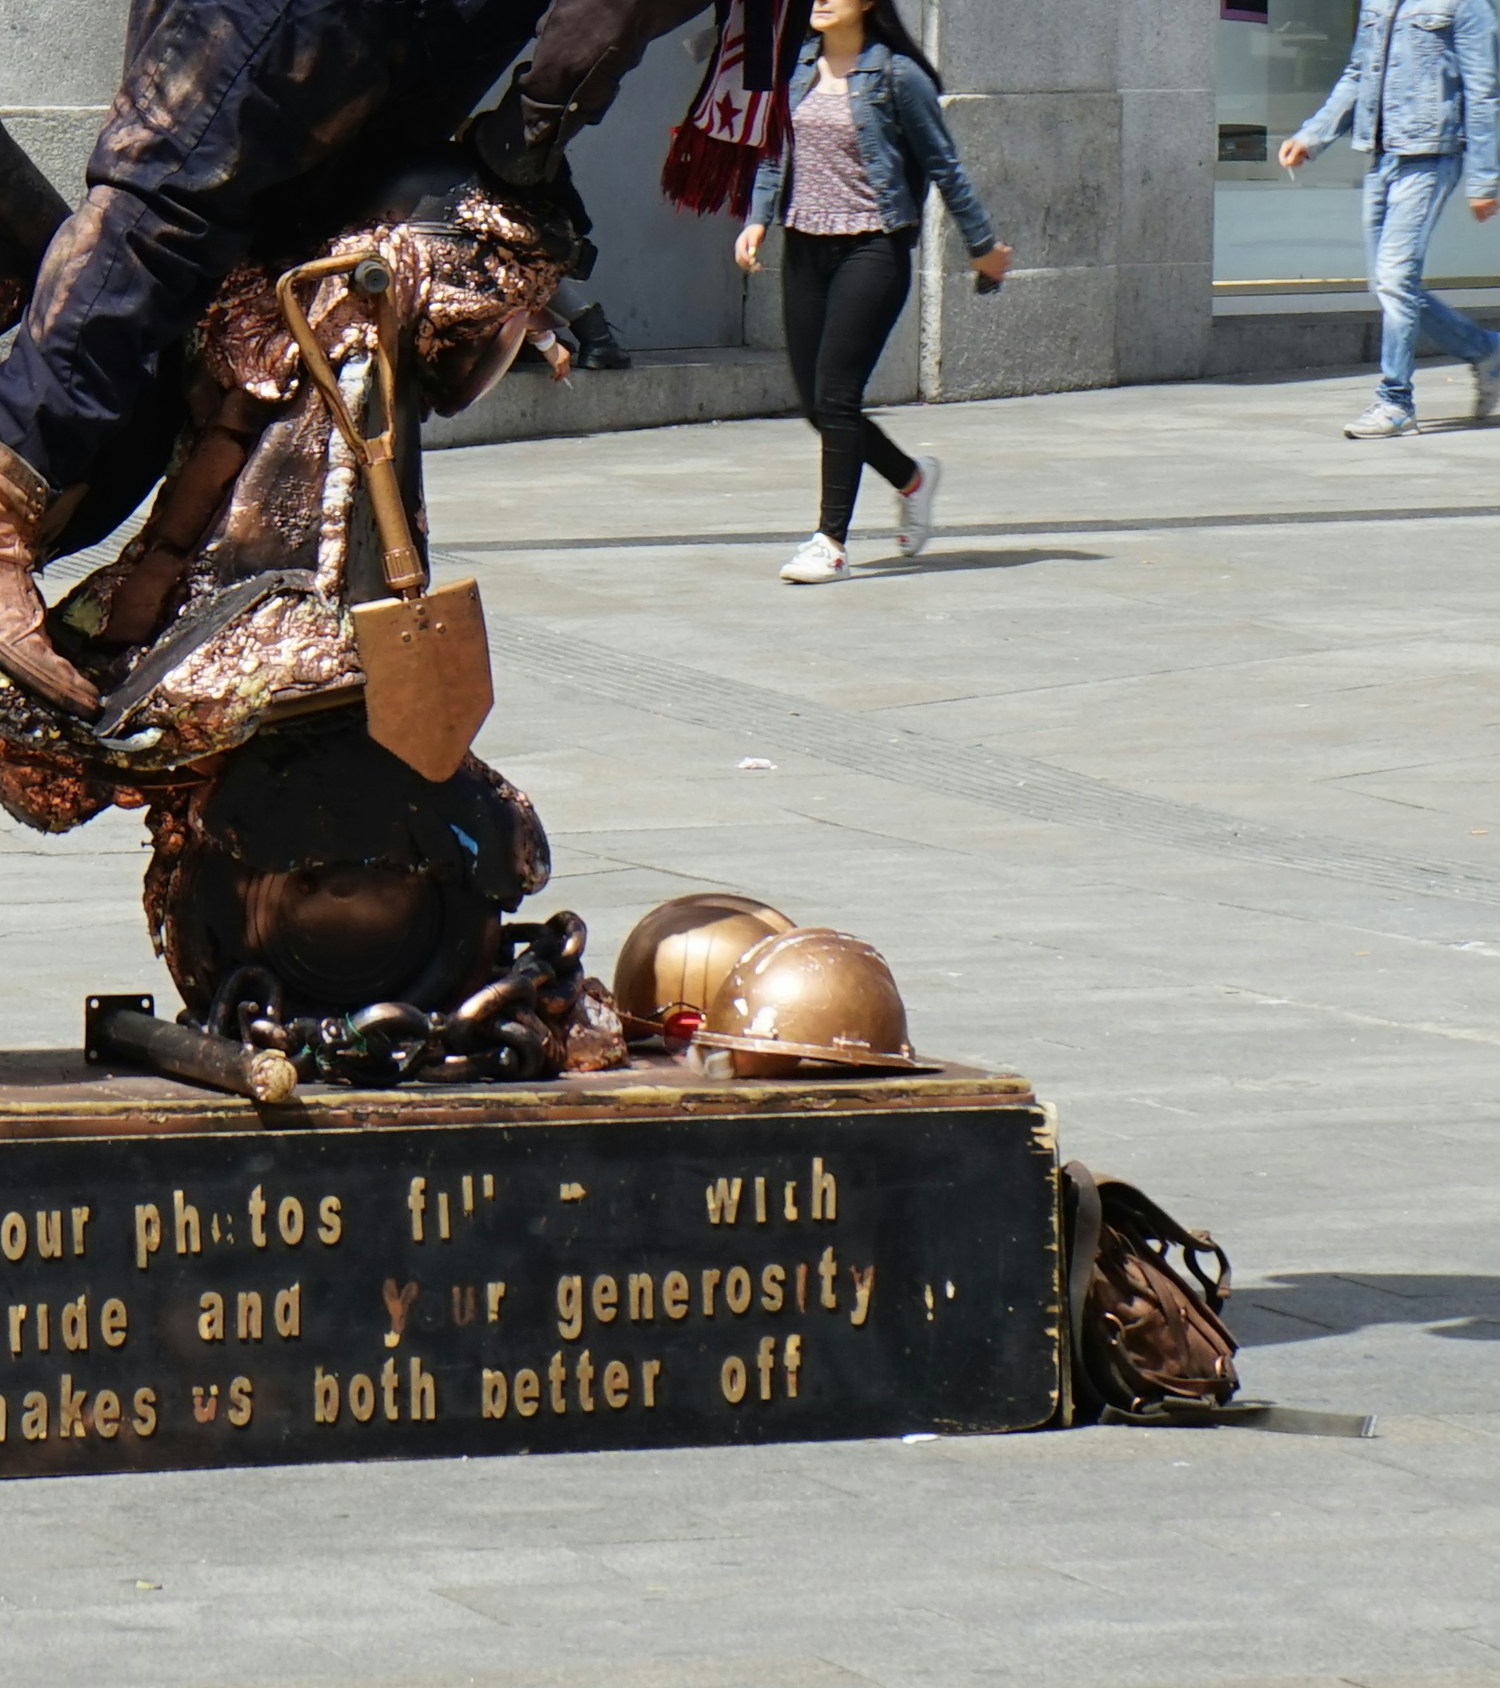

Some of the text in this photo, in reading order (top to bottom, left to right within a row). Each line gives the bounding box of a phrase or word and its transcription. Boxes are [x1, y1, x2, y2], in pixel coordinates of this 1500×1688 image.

[198, 1280, 300, 1341] and
[382, 1277, 507, 1348] yur
[557, 1245, 876, 1341] generosity
[192, 1375, 253, 1426] us
[314, 1356, 436, 1423] both
[481, 1349, 661, 1420] better
[720, 1334, 801, 1404] off
